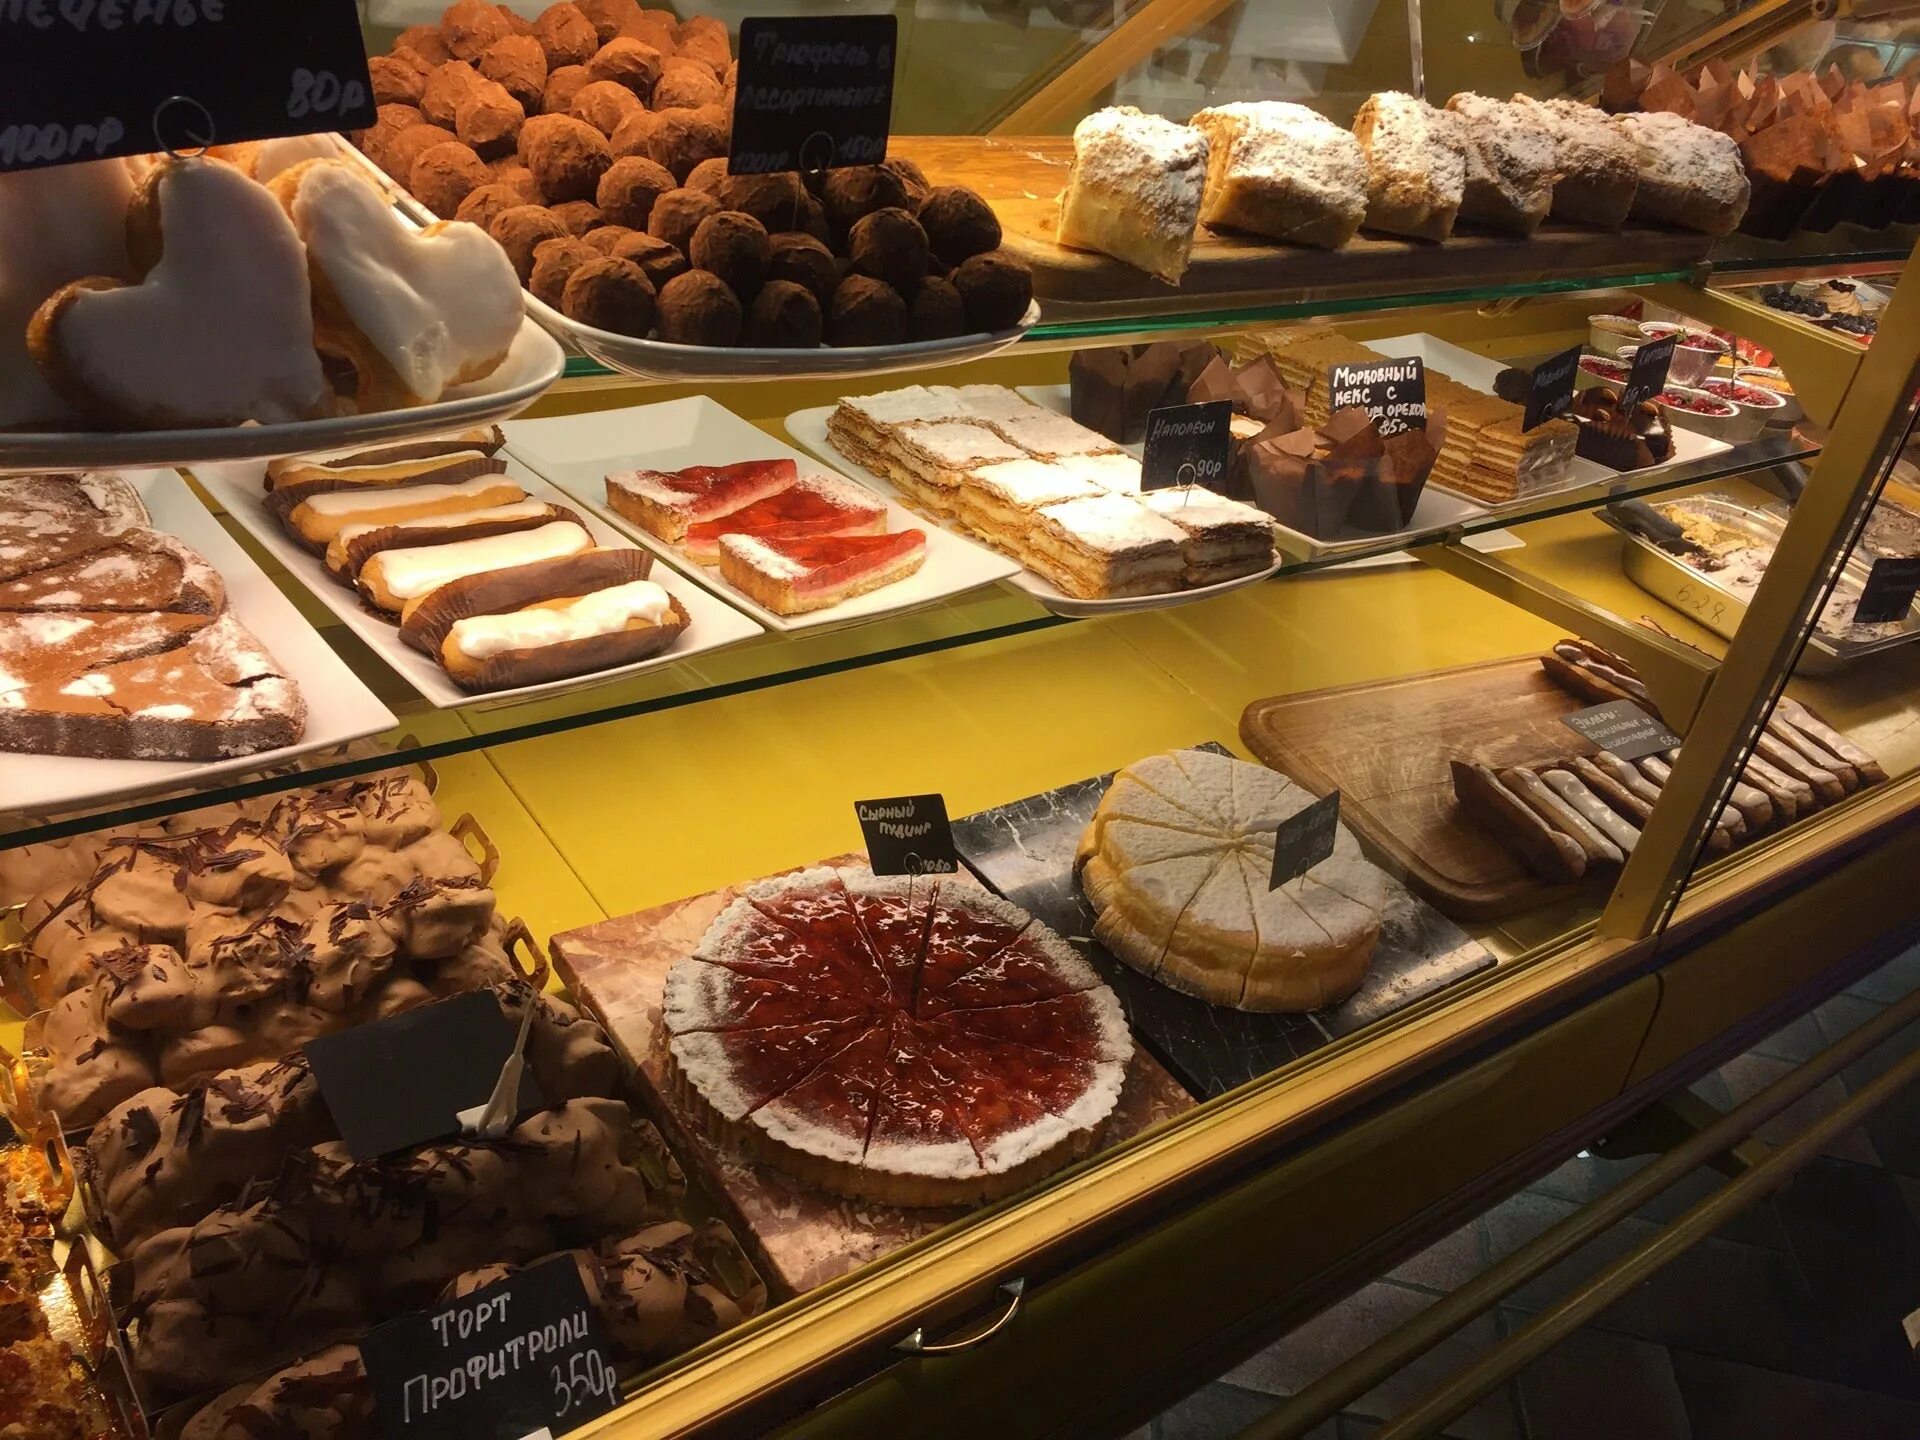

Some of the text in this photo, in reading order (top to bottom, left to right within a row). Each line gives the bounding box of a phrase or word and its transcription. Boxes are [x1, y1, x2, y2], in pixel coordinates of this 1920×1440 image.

[1333, 360, 1417, 388] МОРКОВНЫЙ
[1334, 388, 1371, 406] КЕКС
[860, 799, 915, 821] СЫРНЫЙ
[879, 822, 932, 839] ПУДИНГ
[431, 1292, 511, 1347] ТОРТ
[403, 1310, 588, 1424] ПРОФИТРОЛИ
